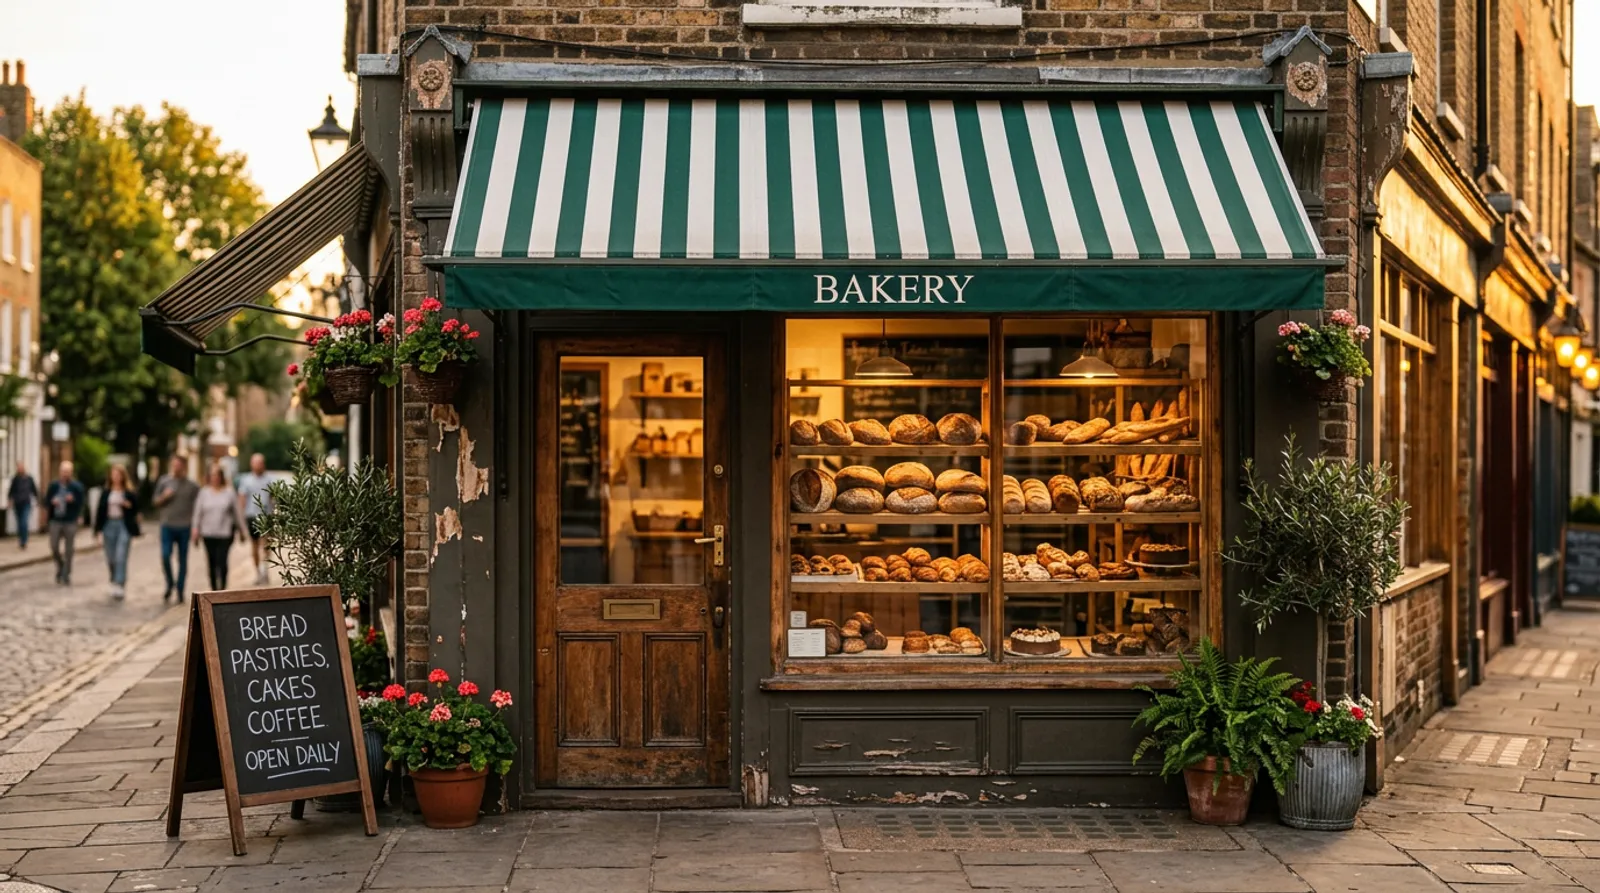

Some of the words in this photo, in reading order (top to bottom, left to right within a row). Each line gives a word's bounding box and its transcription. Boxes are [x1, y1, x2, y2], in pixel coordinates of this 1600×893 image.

[813, 274, 975, 304] BAKERY
[239, 613, 307, 641] BREAD
[231, 643, 330, 674] PASTRIES,
[247, 675, 316, 703] CAKES
[245, 747, 290, 770] OPEN
[297, 740, 340, 765] DAILY
